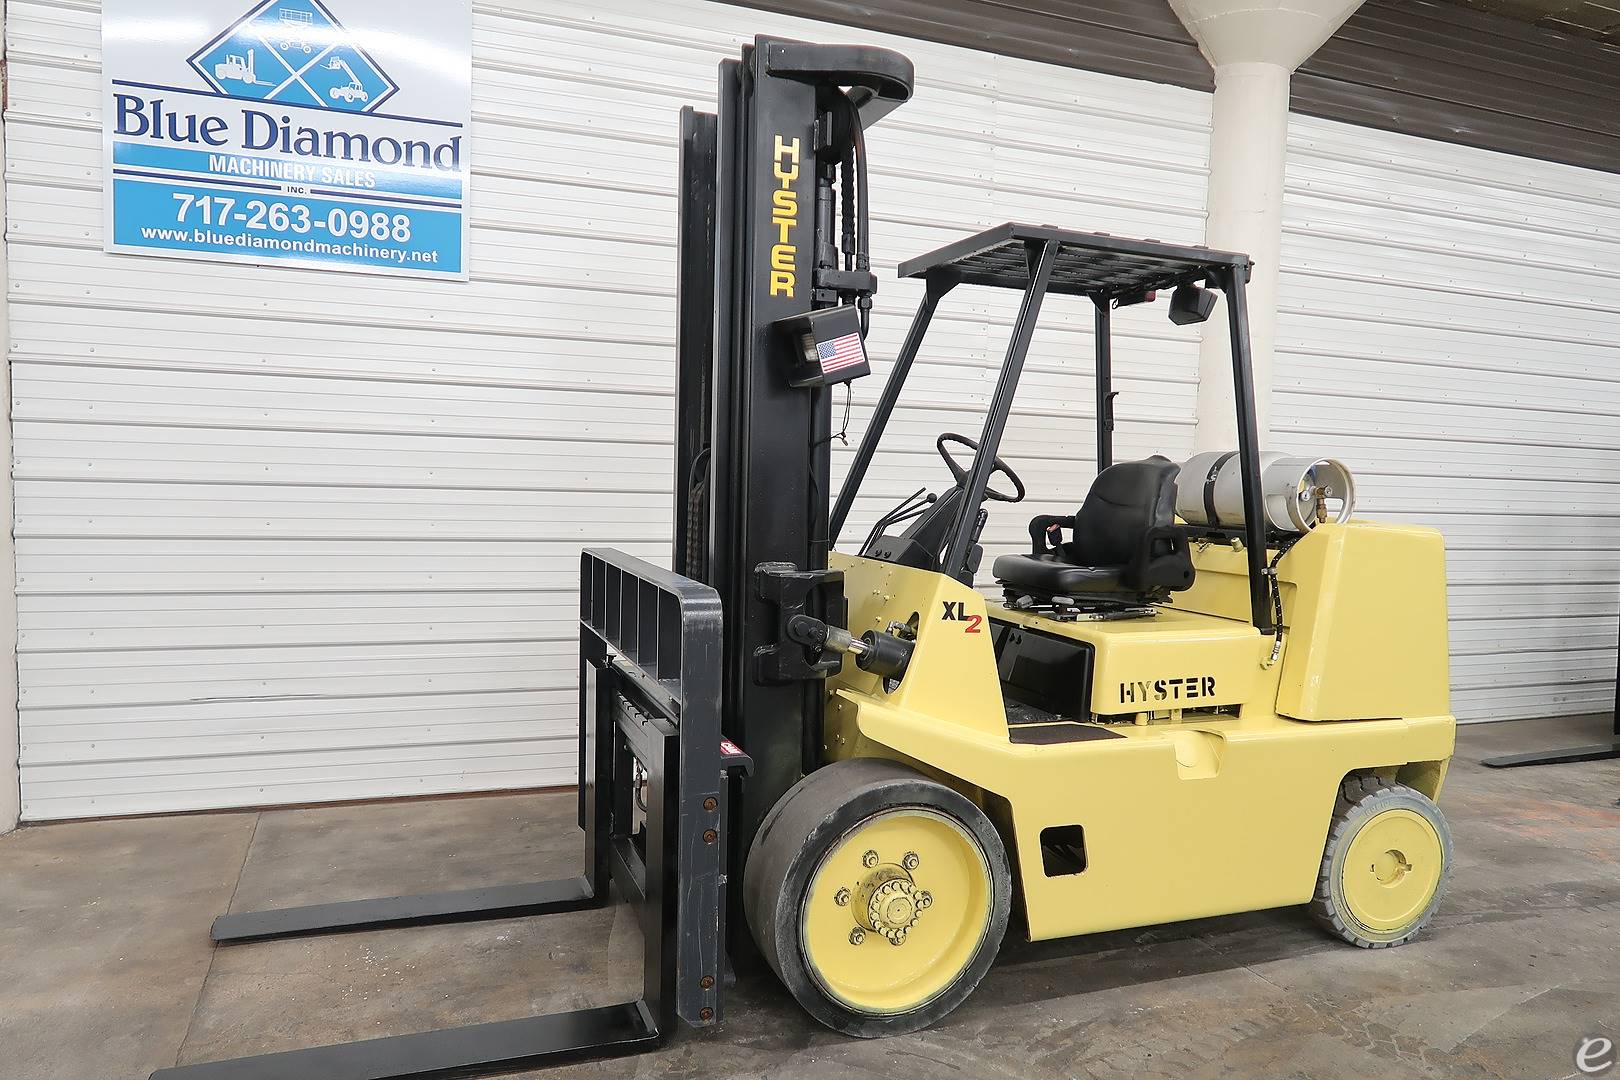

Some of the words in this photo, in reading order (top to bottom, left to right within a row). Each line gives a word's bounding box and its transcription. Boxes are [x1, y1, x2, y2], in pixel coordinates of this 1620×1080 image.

[113, 93, 228, 146] Blue
[241, 109, 462, 172] Diamond
[208, 154, 315, 182] MACHINERY
[321, 165, 376, 188] SALES
[287, 185, 307, 194] INC.
[172, 192, 411, 243] 717-263-0988
[770, 134, 800, 297] HYSTER
[141, 227, 438, 263] www.bluediamondmachinery.net
[1120, 676, 1216, 703] HYSTER
